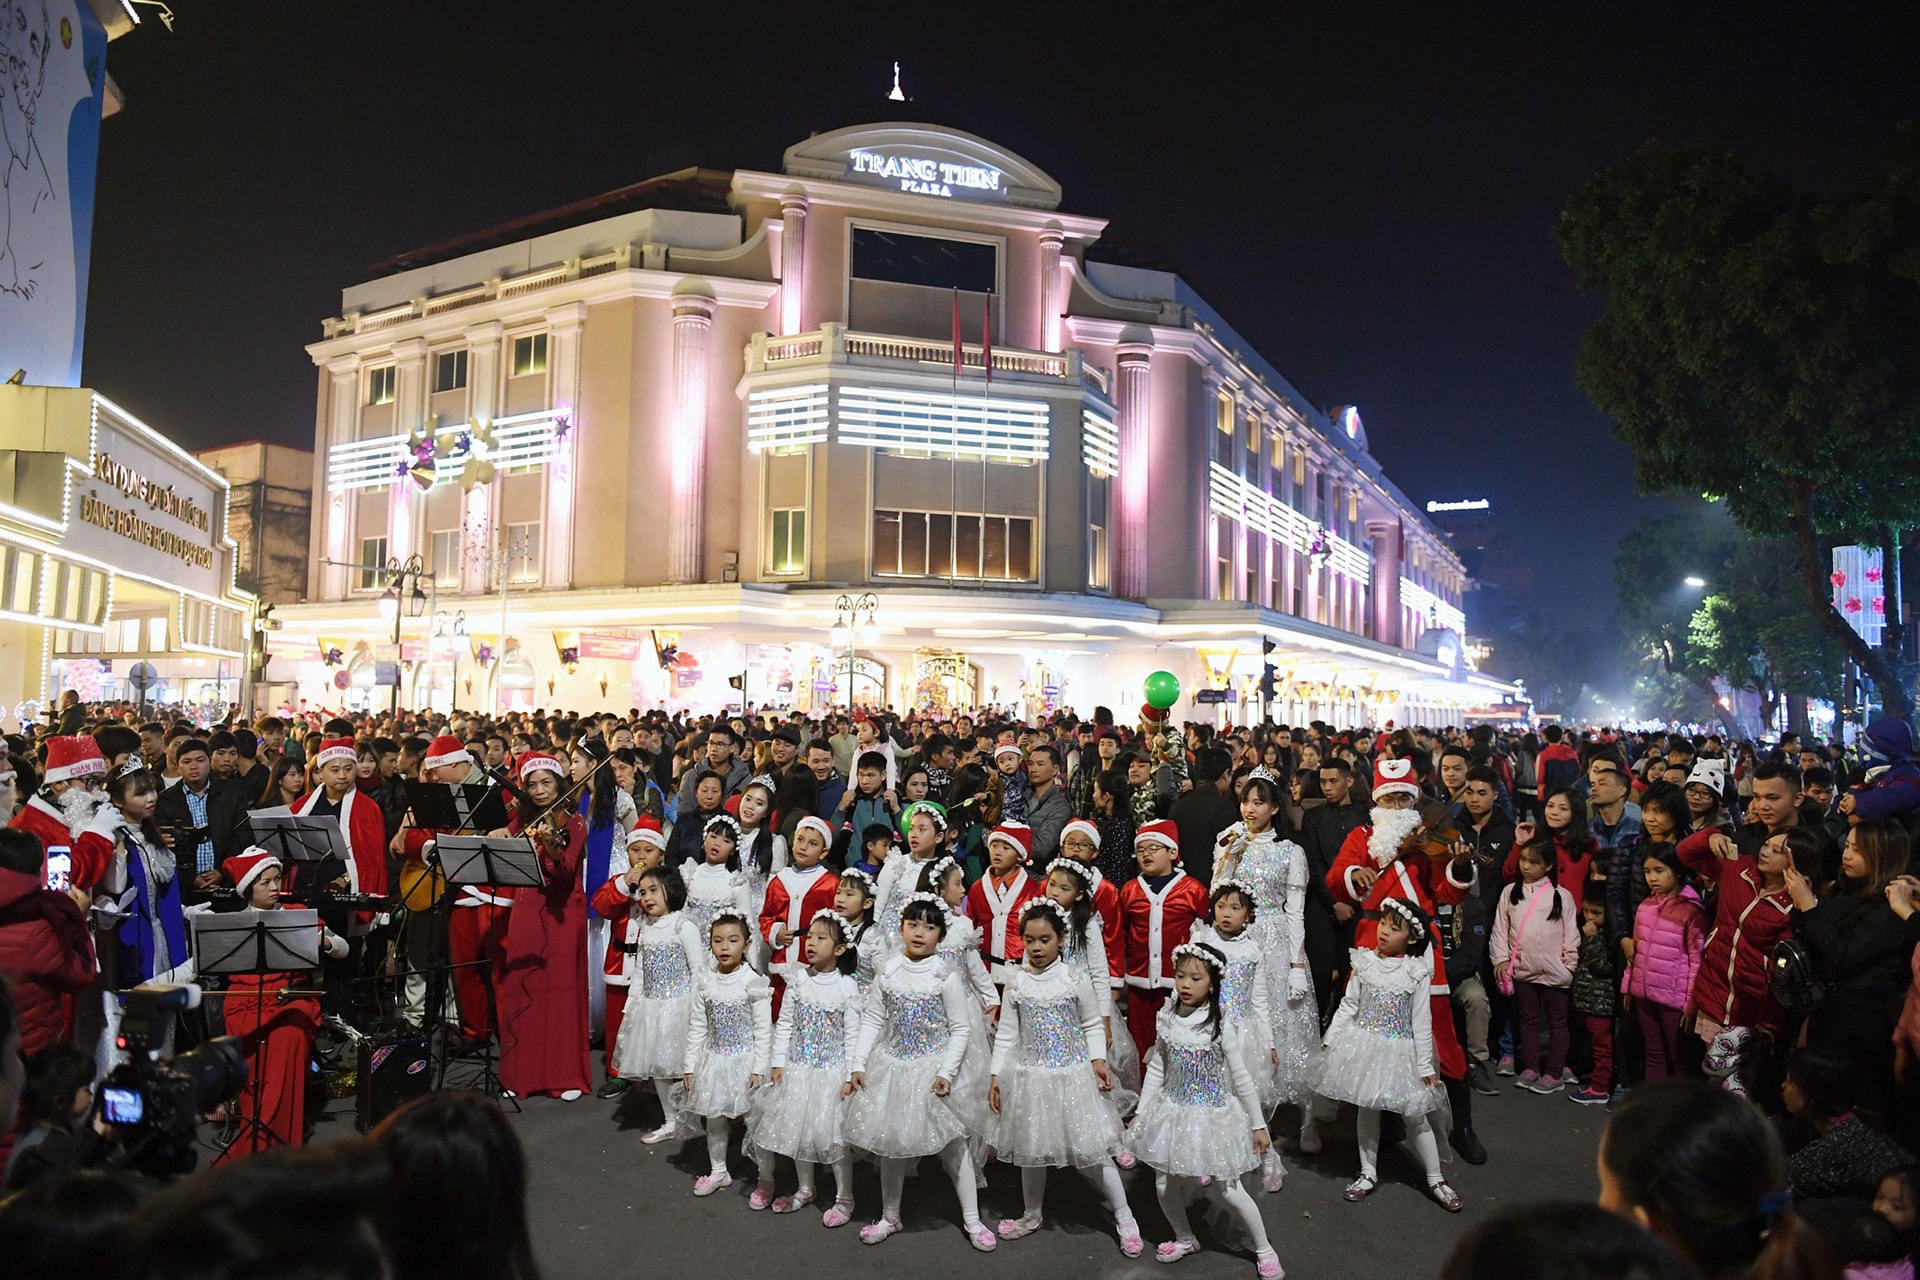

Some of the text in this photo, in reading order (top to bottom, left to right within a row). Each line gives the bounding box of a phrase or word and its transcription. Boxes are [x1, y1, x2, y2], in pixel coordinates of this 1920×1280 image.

[850, 151, 1001, 190] TRANG TIEN
[900, 179, 952, 197] PLAZA
[115, 509, 151, 544] HOÀNG
